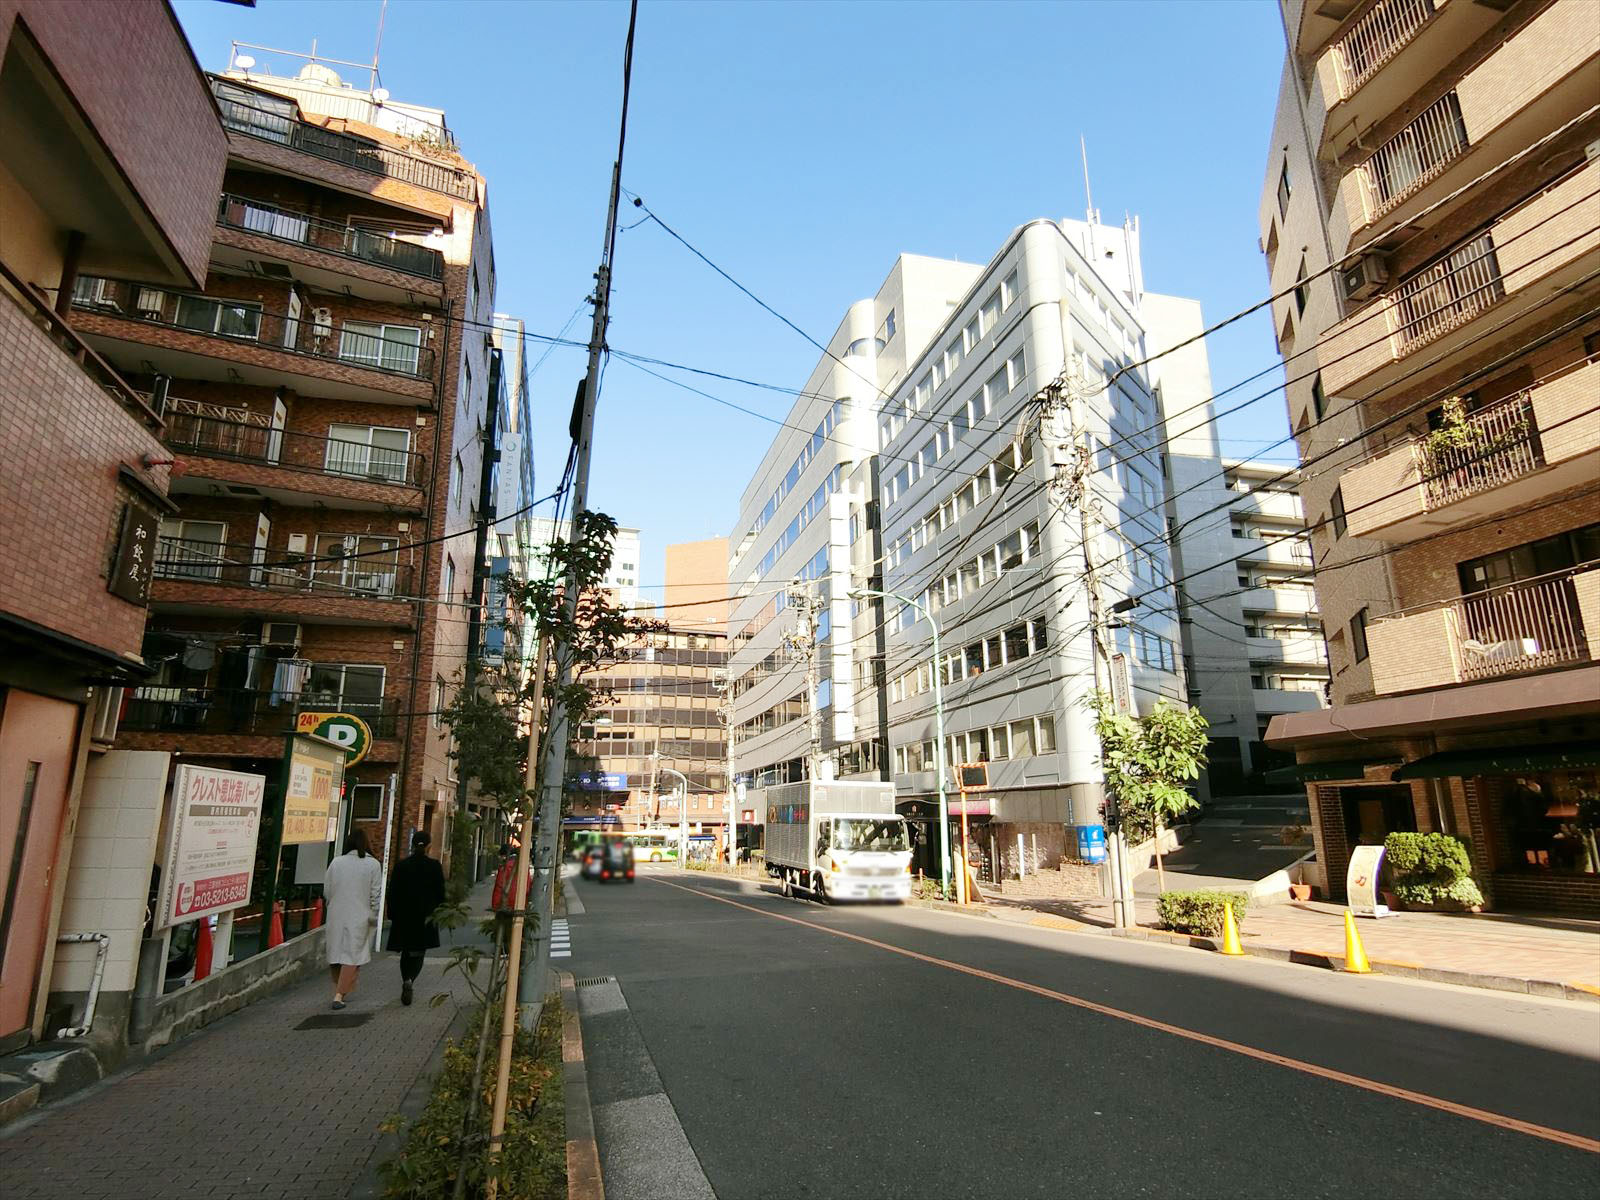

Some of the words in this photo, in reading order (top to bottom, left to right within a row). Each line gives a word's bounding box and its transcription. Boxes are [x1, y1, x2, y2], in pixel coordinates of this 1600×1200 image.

[299, 714, 320, 727] 24h
[191, 775, 261, 803] クレスト恵比寿パーク
[200, 884, 247, 908] 03-5213-6346
